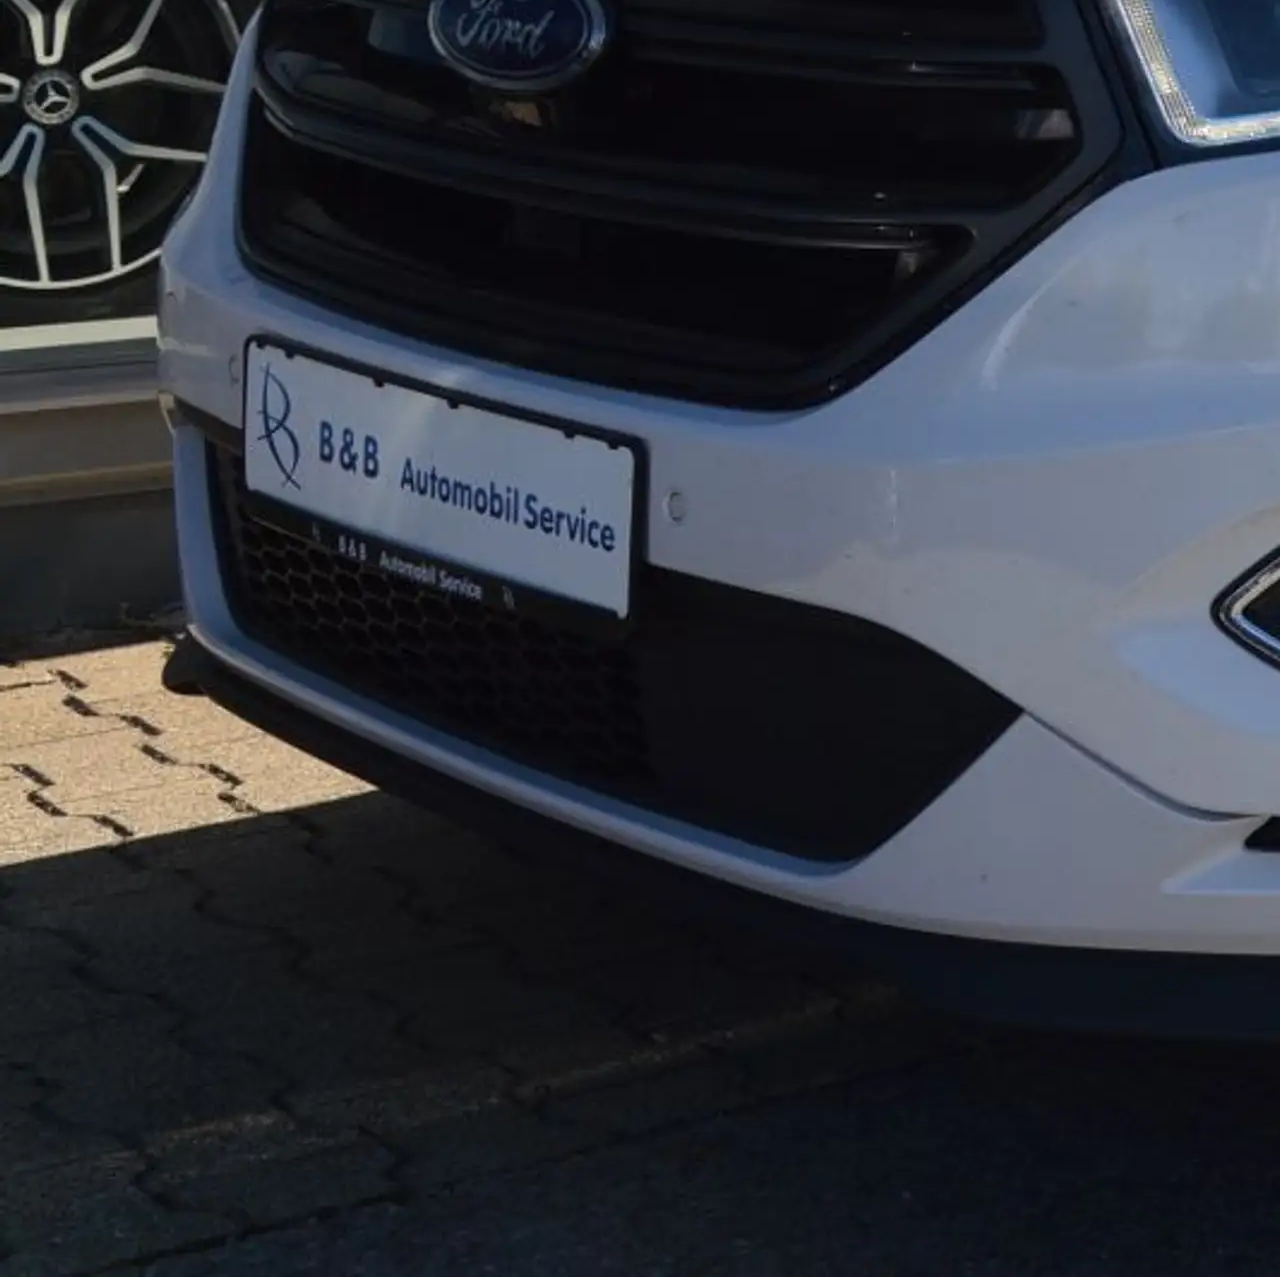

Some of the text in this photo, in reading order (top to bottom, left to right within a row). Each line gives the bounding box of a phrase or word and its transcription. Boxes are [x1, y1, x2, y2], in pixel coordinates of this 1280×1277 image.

[400, 457, 519, 524] Automobil
[524, 493, 616, 553] Service
[379, 550, 436, 585] Automobil
[439, 570, 483, 601] Service
